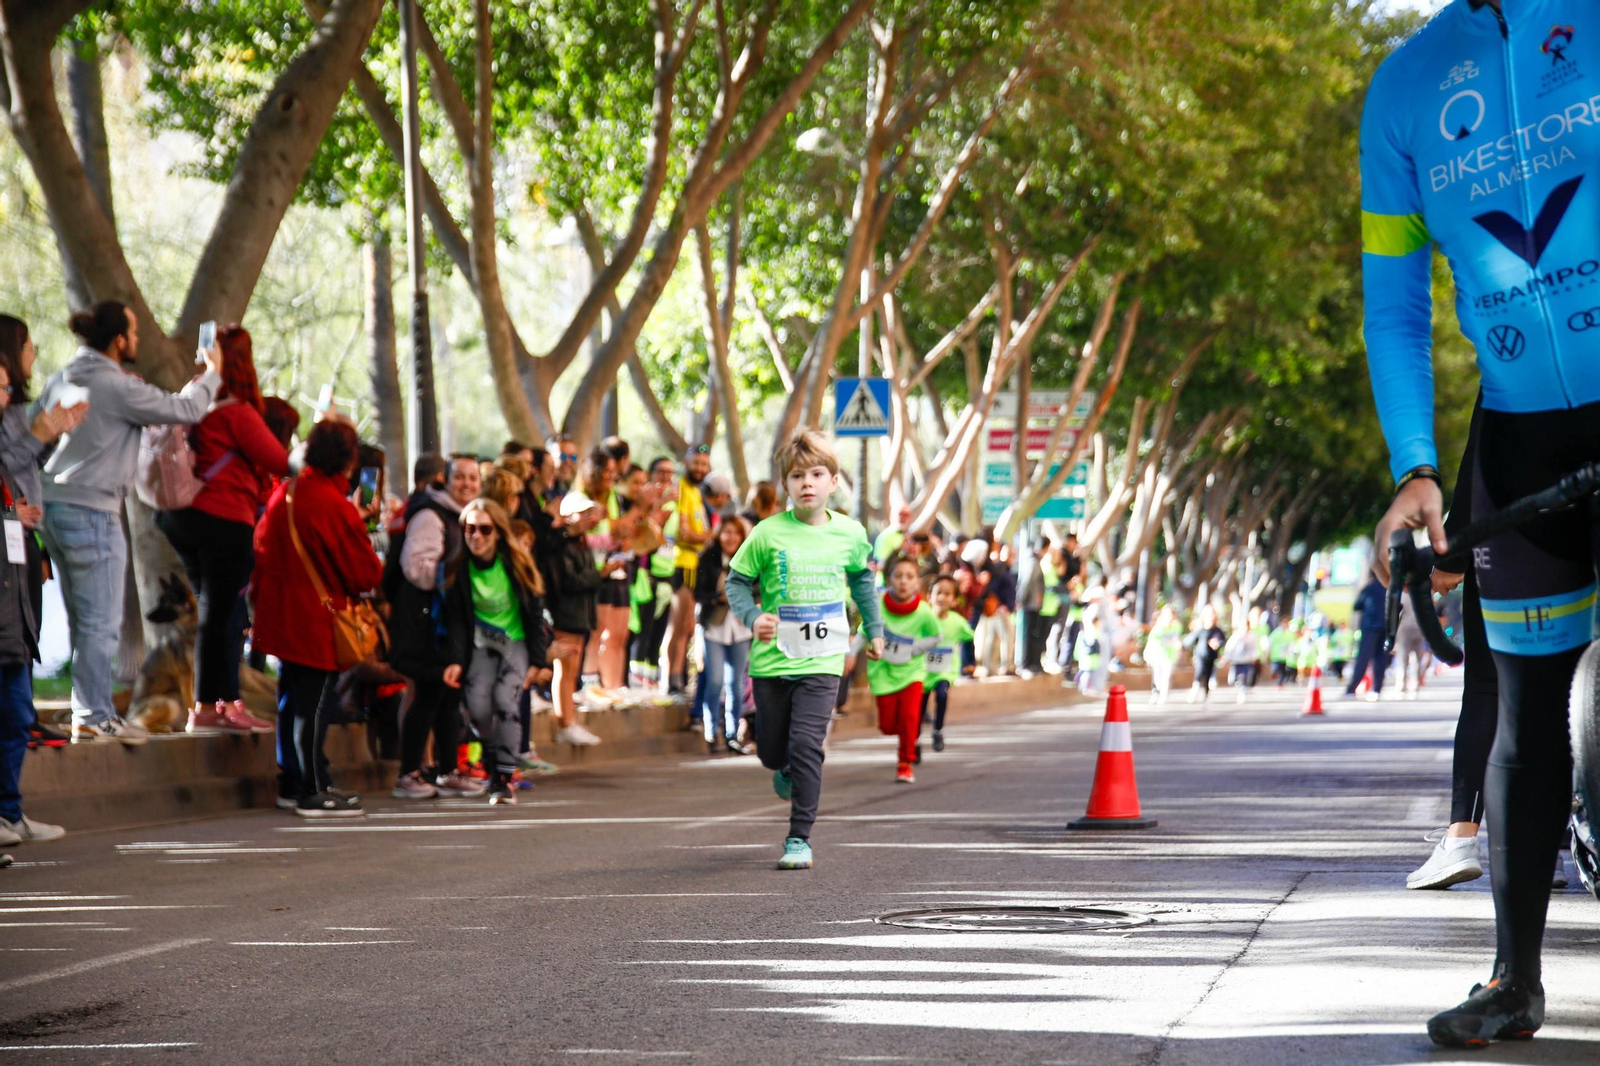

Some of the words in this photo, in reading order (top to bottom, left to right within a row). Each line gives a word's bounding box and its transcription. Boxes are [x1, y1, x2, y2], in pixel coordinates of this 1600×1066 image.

[1430, 95, 1600, 193] BIKESTORE
[789, 574, 829, 586] contra
[800, 621, 828, 640] 16
